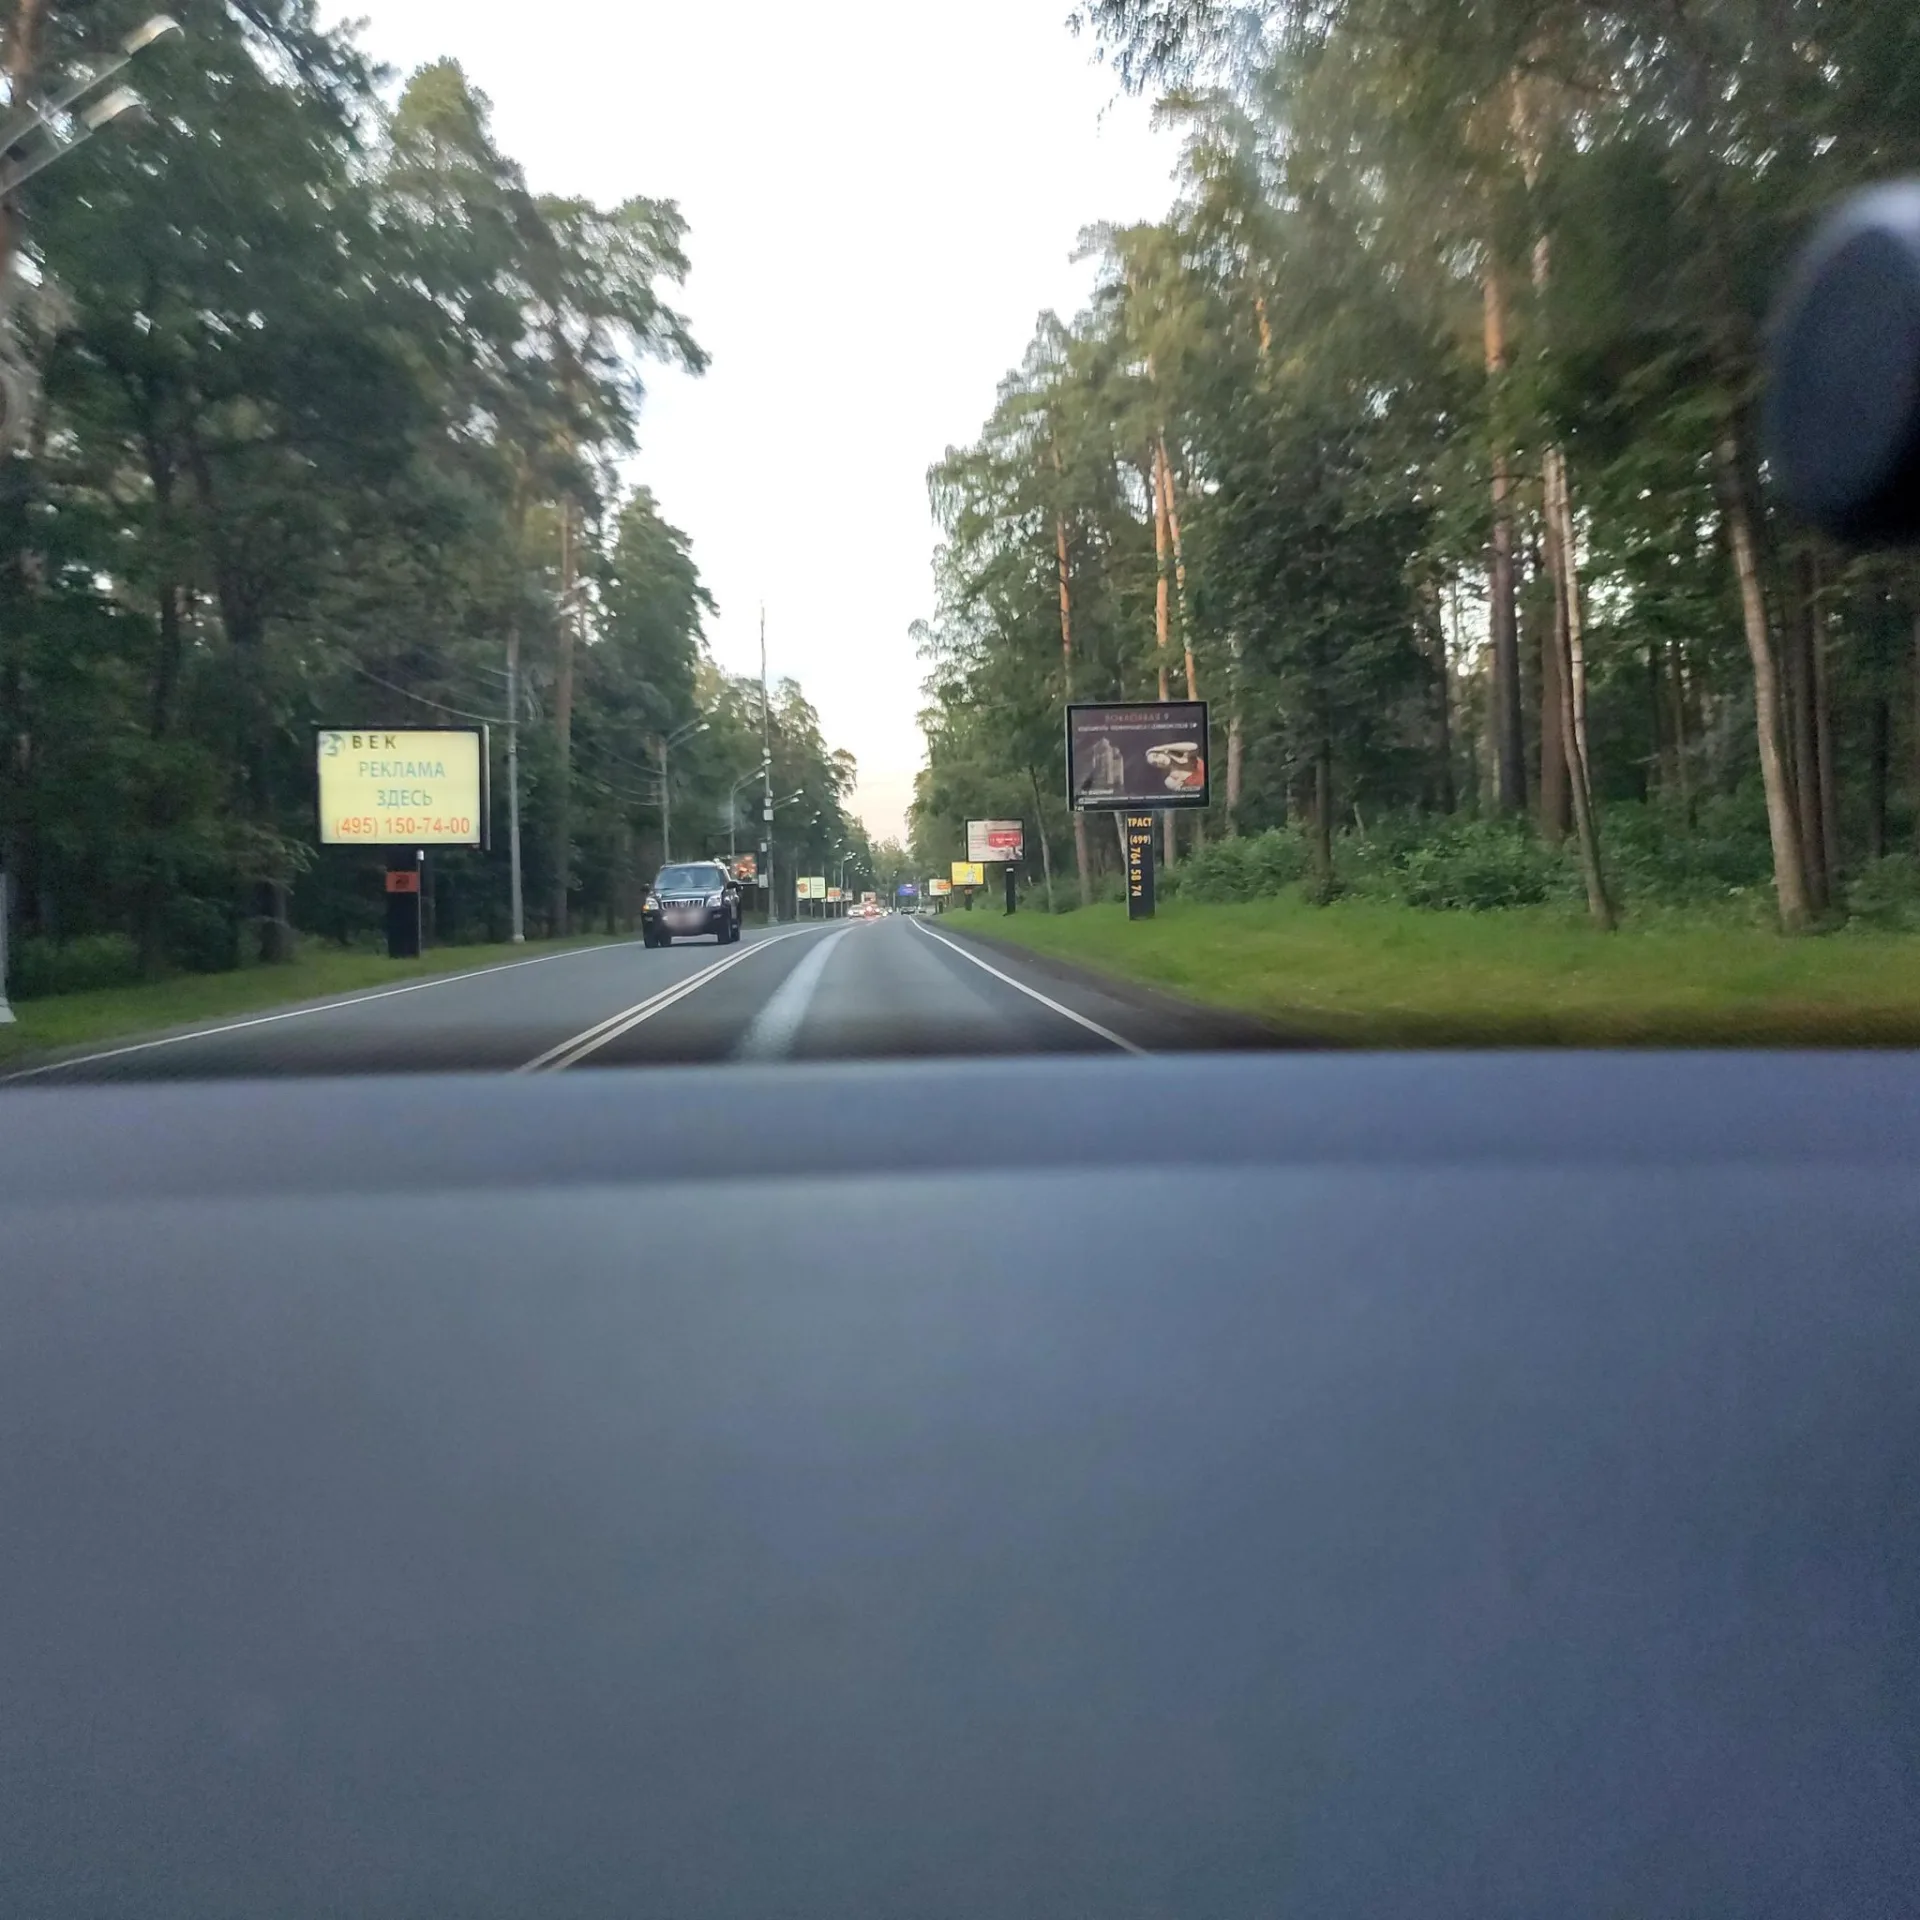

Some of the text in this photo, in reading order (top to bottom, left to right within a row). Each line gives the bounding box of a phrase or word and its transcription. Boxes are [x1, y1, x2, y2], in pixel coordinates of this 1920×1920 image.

[352, 736, 397, 750] ВЕК
[359, 761, 446, 778] РЕКЛАМА
[377, 789, 433, 808] ЗДЕСЬ
[335, 816, 470, 837] (495) 150-74-00
[1128, 818, 1152, 827] ТРАСТ
[1129, 836, 1151, 845] (499)
[1131, 847, 1142, 897] 764 58 74
